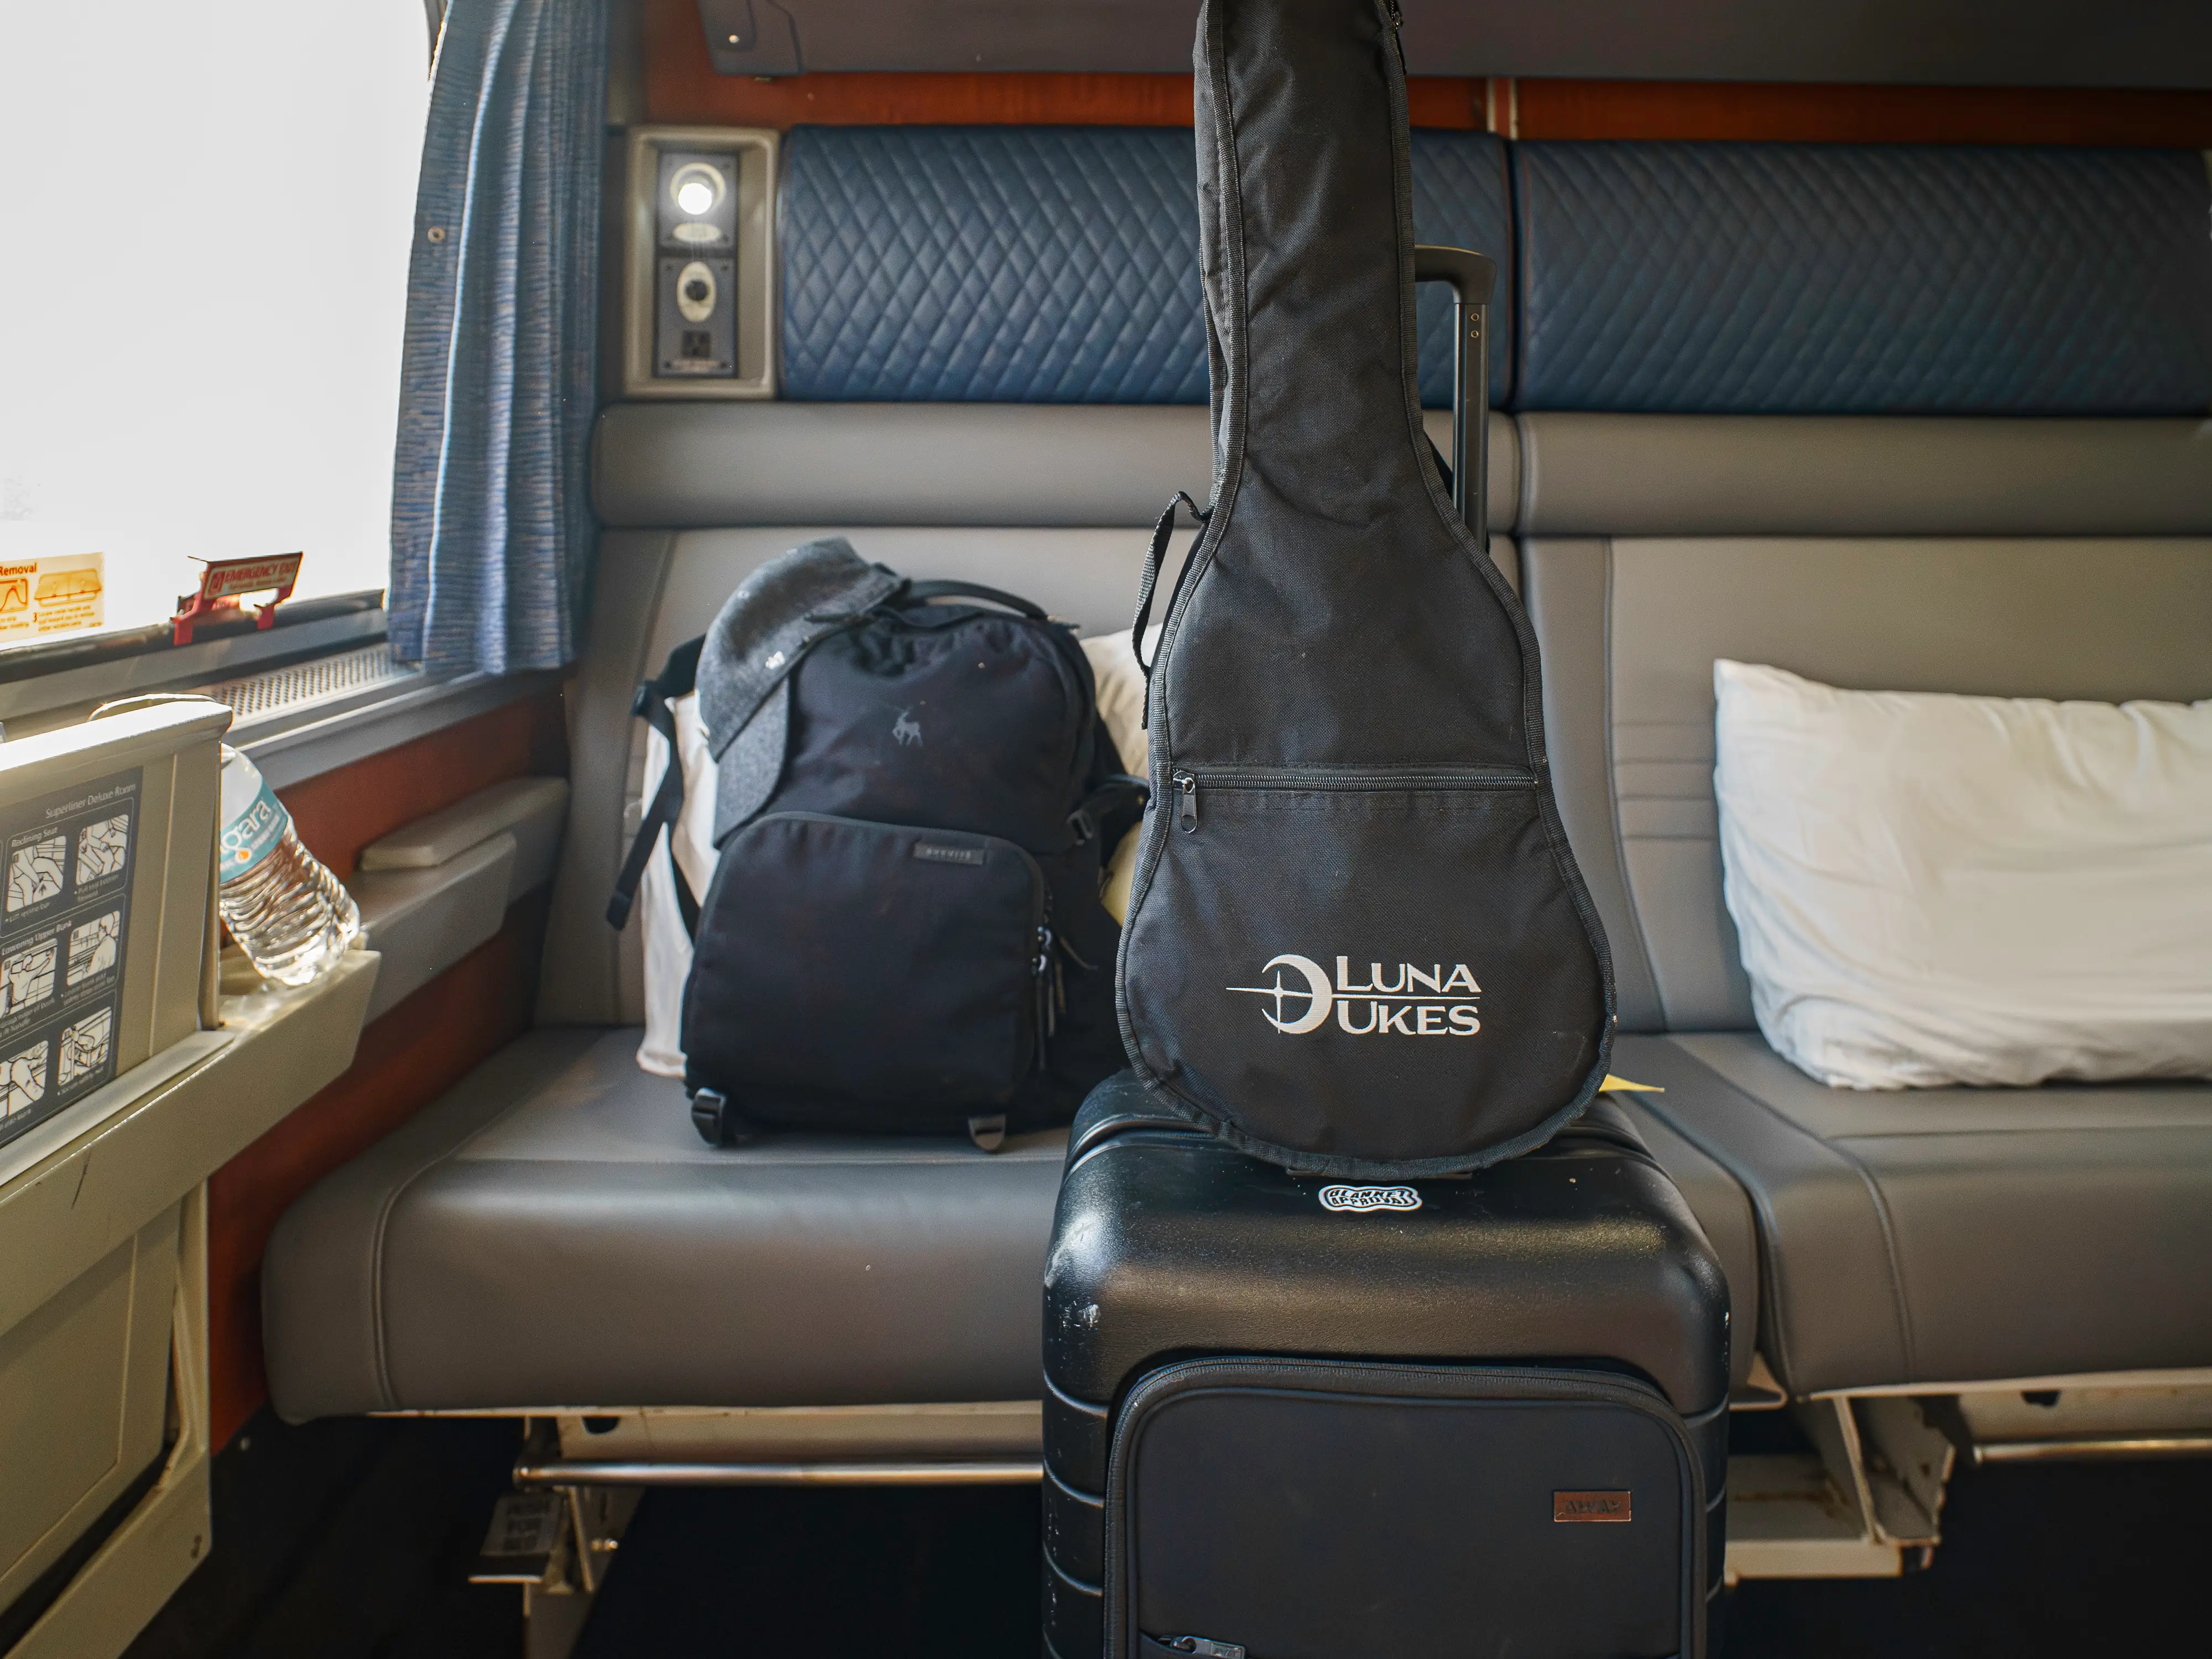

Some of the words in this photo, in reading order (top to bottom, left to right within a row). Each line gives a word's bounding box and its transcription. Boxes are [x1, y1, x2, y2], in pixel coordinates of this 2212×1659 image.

[0, 562, 37, 576] Removal
[45, 798, 87, 819] Superliner
[87, 789, 114, 806] Deluxe
[114, 783, 136, 797] Room
[1336, 956, 1482, 994] LUNA
[1337, 999, 1481, 1036] UKES
